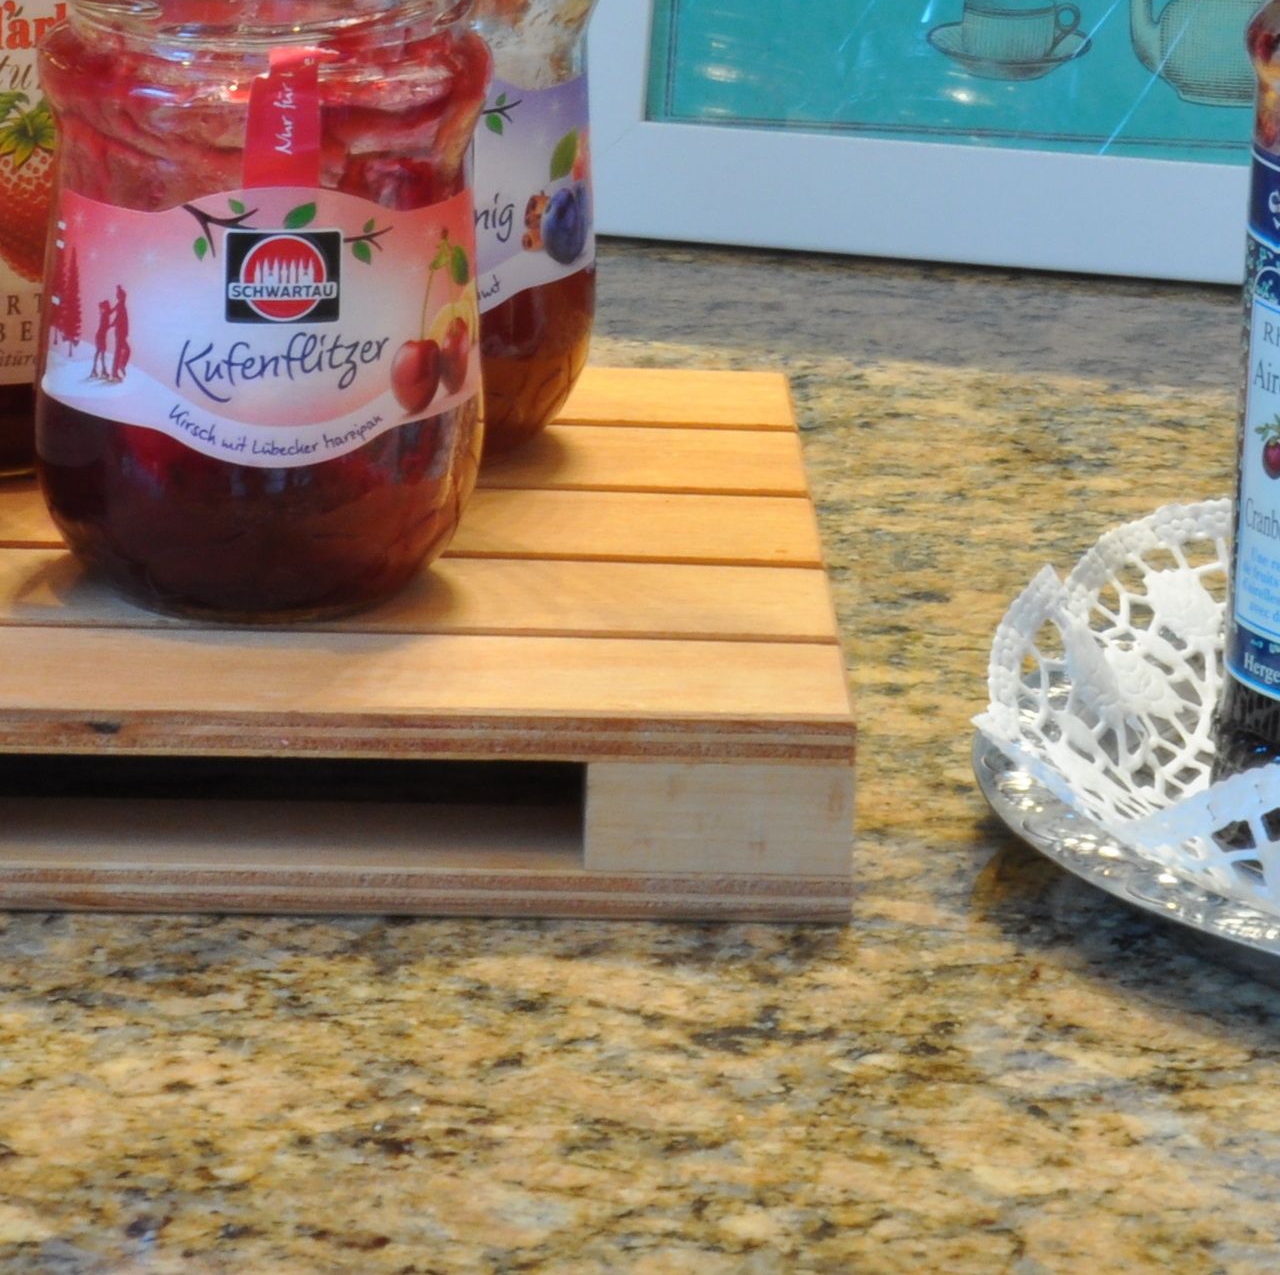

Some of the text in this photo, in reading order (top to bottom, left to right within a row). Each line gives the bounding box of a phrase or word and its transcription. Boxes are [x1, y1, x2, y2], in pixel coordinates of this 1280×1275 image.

[273, 82, 296, 109] für
[275, 115, 293, 155] Nur
[474, 192, 515, 243] nig
[232, 284, 333, 299] SCHWARTAU
[176, 331, 389, 404] Kufenflitzer
[169, 404, 216, 445] Kirsch
[221, 436, 246, 453] mit
[251, 439, 318, 458] Lübecker
